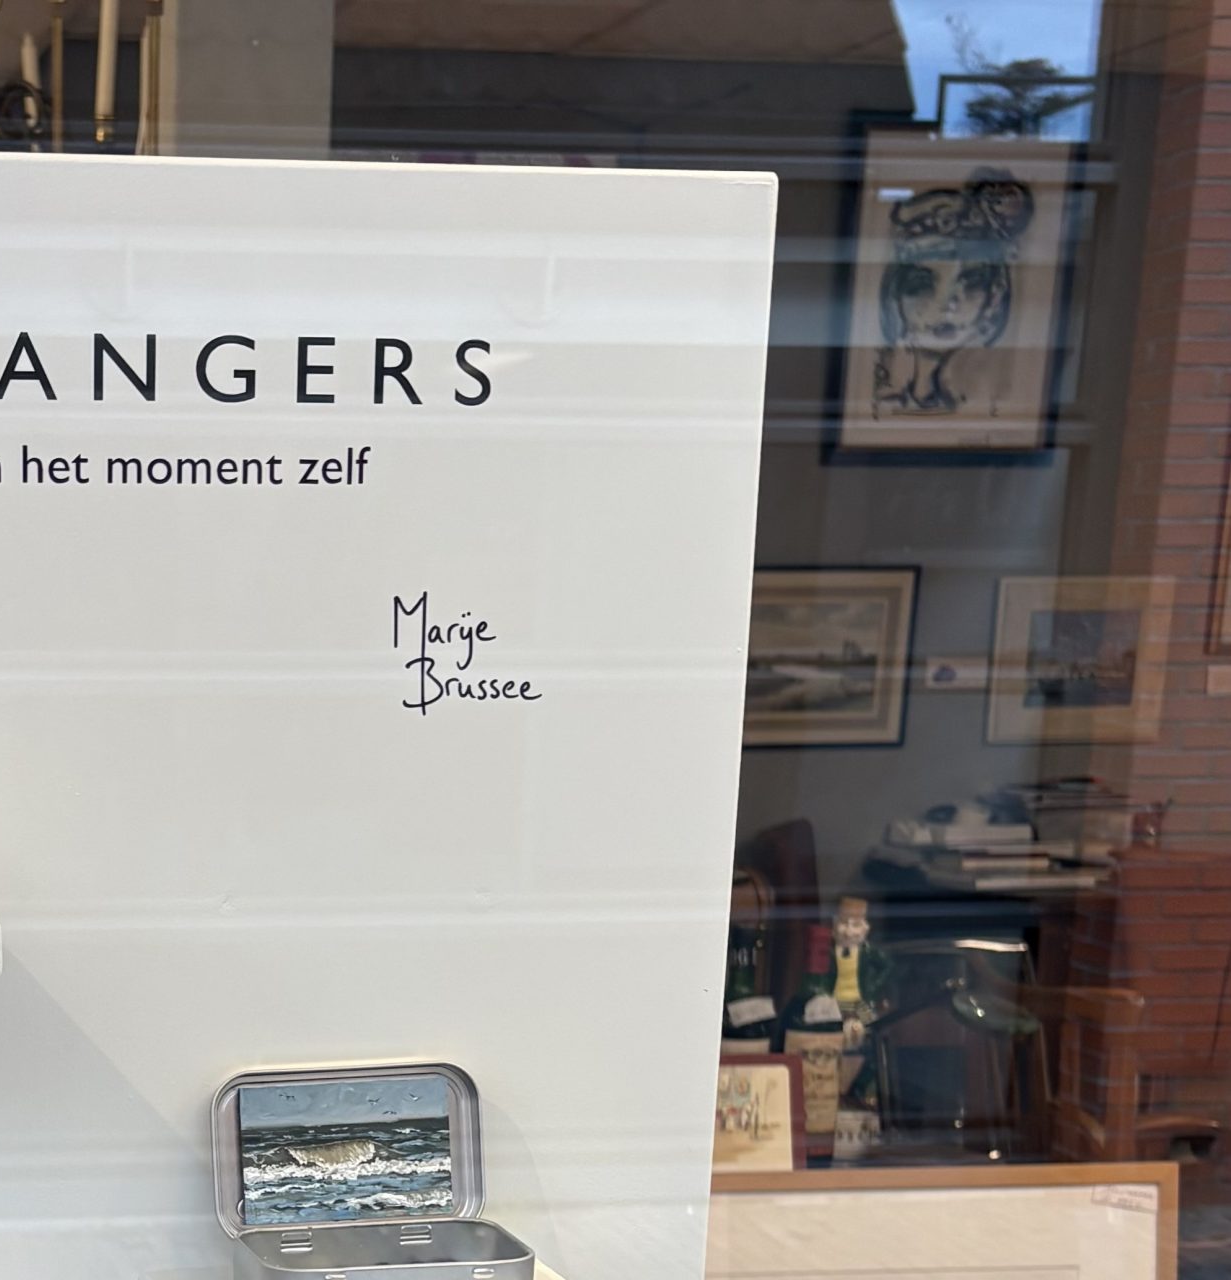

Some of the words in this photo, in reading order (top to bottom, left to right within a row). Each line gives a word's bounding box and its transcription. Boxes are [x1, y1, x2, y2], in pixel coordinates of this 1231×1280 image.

[21, 444, 90, 484] het
[107, 455, 283, 485] moment
[298, 446, 372, 486] zelf
[402, 657, 543, 716] Brussee
